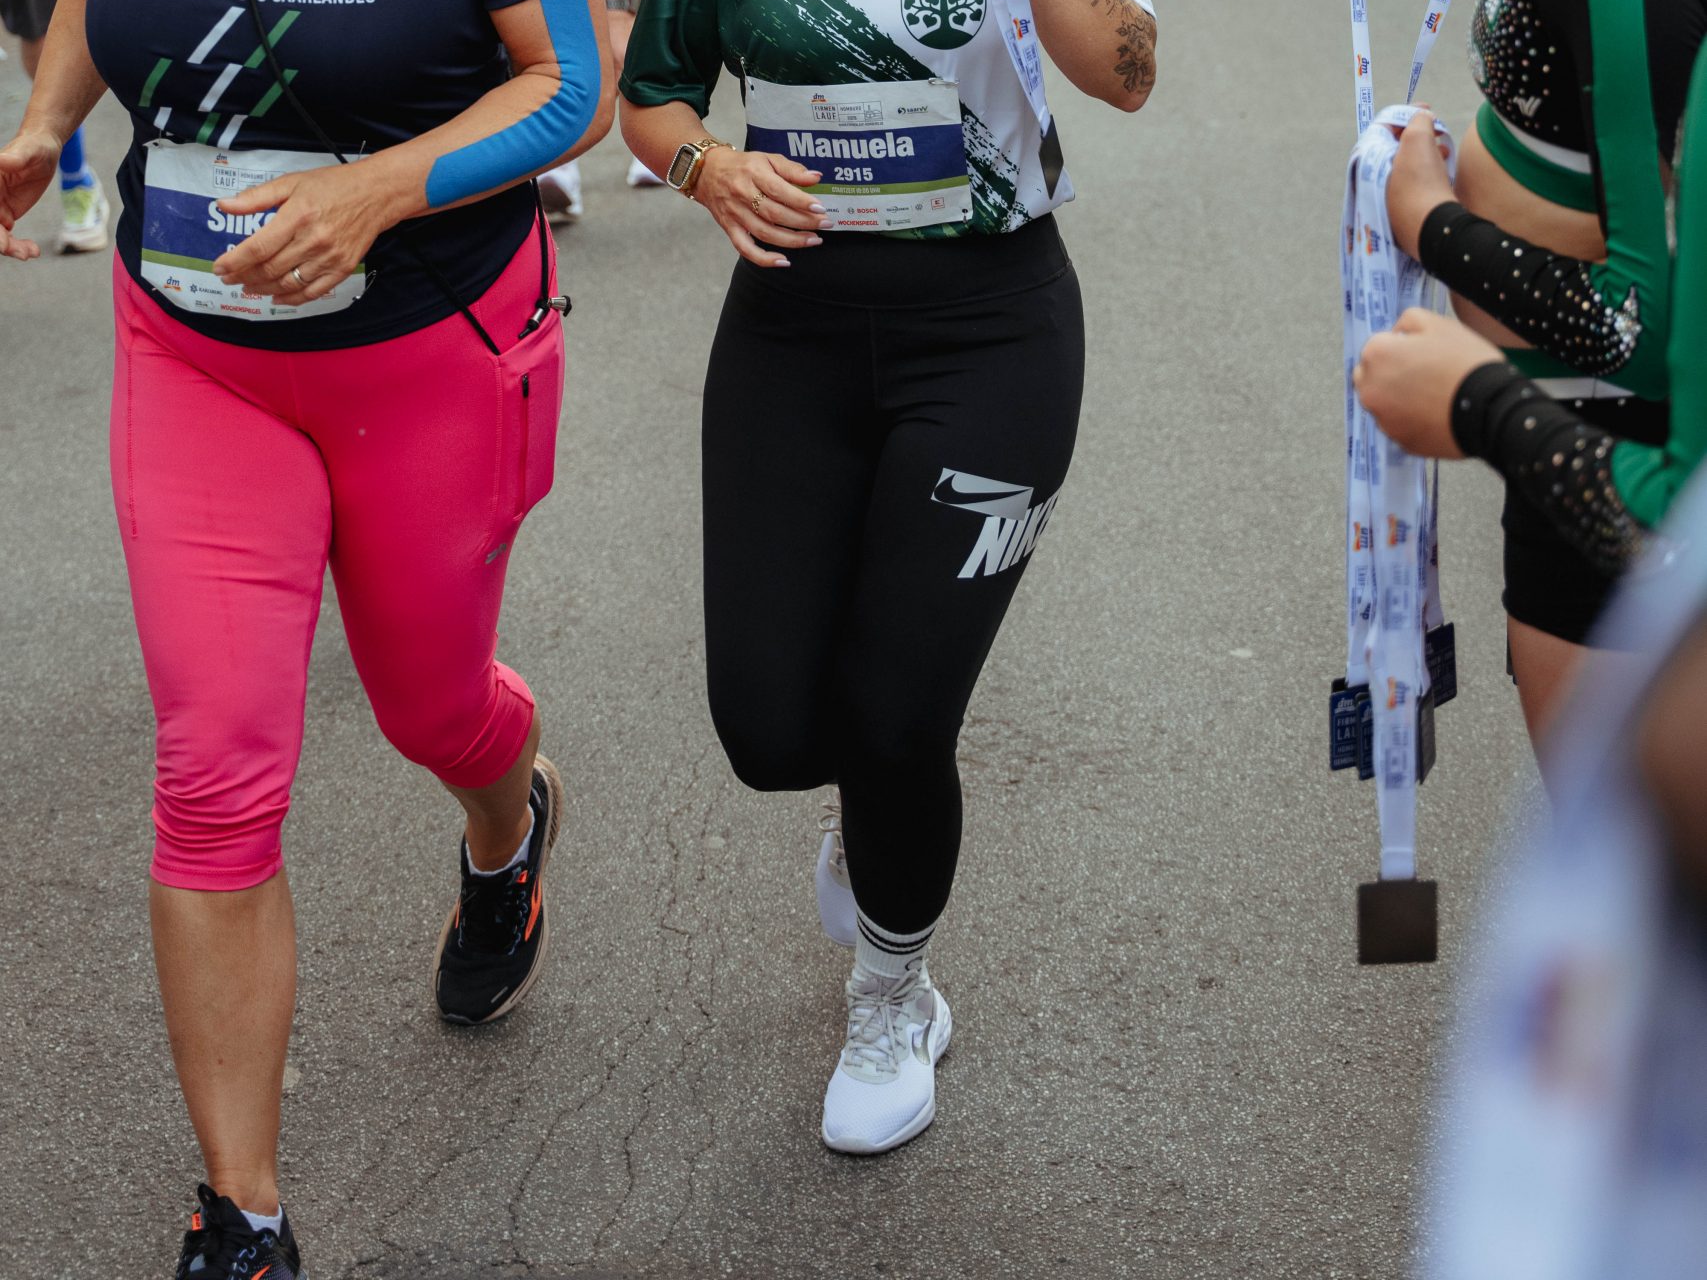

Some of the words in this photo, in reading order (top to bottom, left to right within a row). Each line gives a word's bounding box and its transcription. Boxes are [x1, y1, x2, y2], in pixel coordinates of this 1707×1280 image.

[1020, 18, 1031, 35] dm
[1425, 12, 1437, 30] dm
[787, 131, 915, 159] Manuela
[215, 176, 236, 188] LAUF
[834, 166, 873, 181] 2915
[207, 200, 277, 236] Silk
[166, 276, 180, 287] dm
